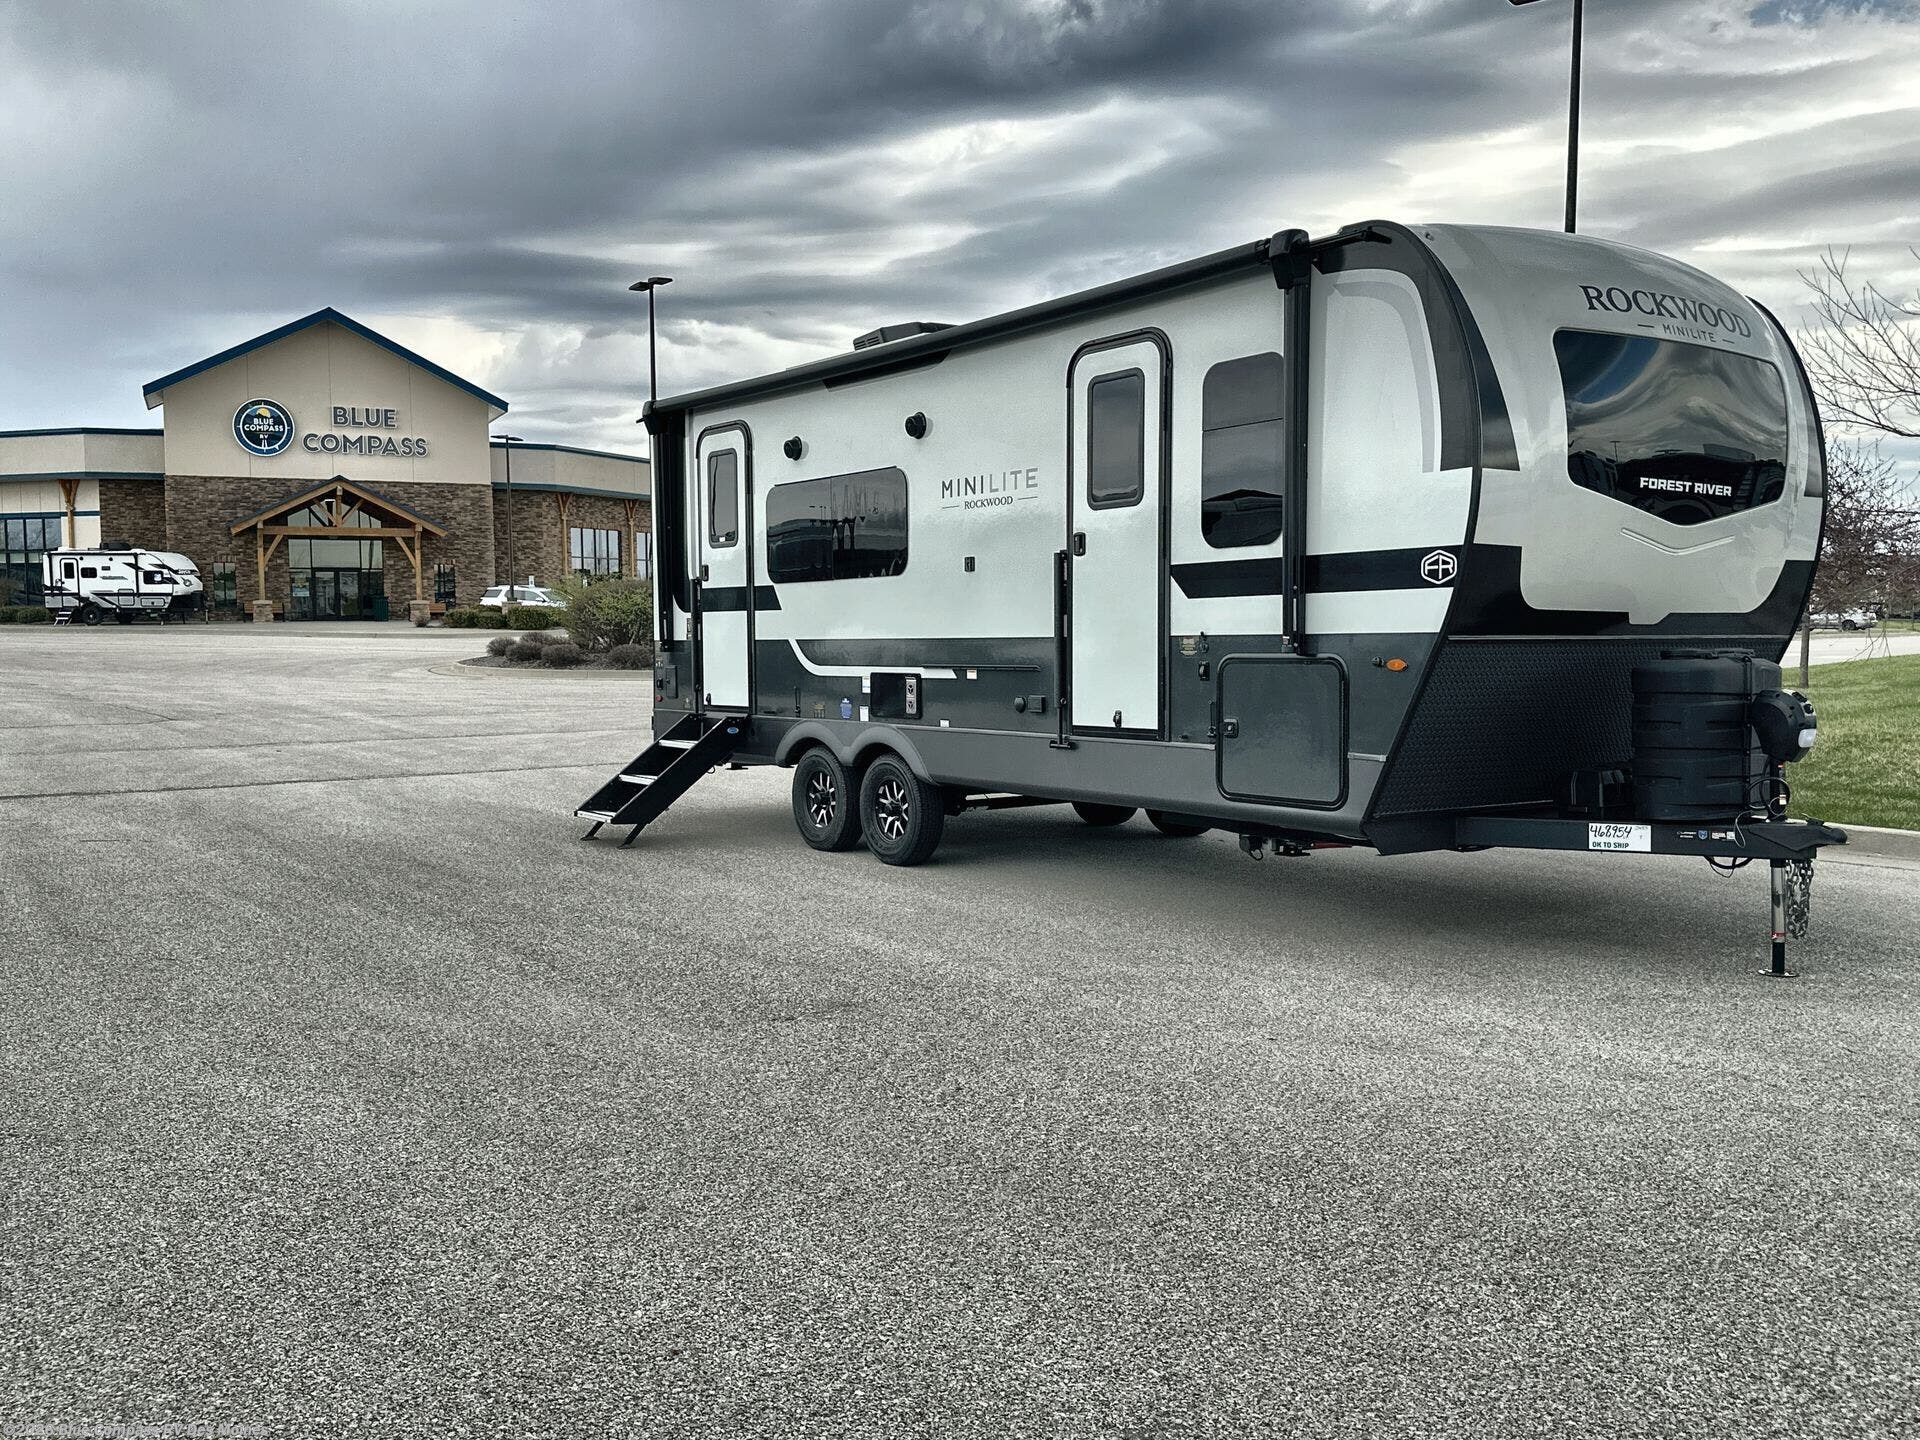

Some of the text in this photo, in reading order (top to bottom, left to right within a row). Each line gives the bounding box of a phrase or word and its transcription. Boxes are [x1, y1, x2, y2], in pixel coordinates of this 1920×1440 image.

[1577, 284, 1751, 338] ROCKWOOD
[1662, 324, 1717, 343] MINILITE
[332, 405, 397, 428] BLUE
[244, 424, 284, 432] COMPASS
[302, 432, 428, 457] COMPASS
[941, 467, 1039, 499] MINILITE
[1640, 477, 1732, 497] FOREST RIVER
[964, 496, 1014, 510] ROCKWOOD
[1589, 825, 1632, 838] 468954
